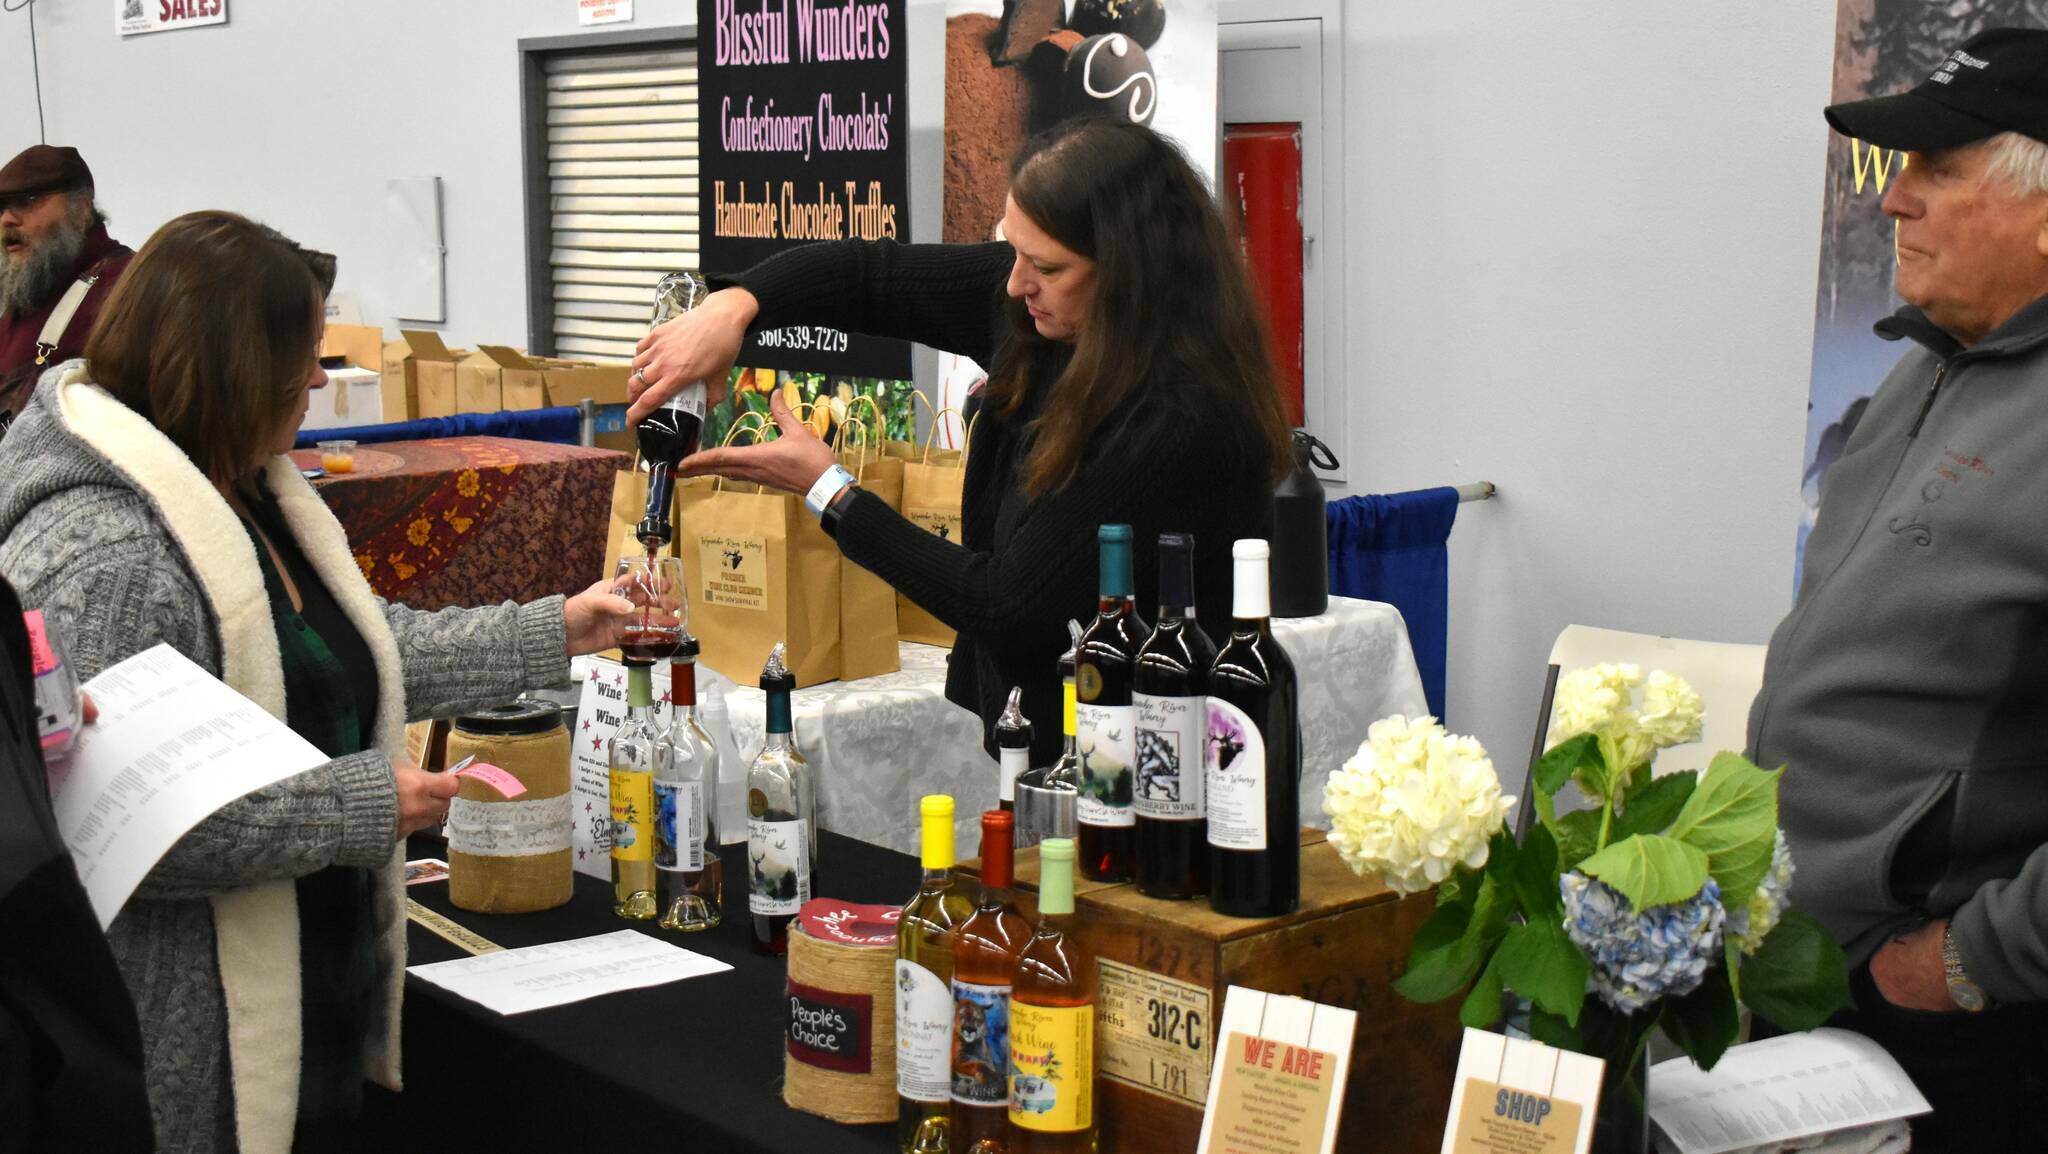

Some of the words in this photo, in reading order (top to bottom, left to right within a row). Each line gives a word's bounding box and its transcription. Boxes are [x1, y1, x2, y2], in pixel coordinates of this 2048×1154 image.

[715, 0, 790, 66] Blissful
[796, 0, 890, 64] Wunders
[721, 95, 813, 162] Confectionery
[714, 181, 778, 239] Handmade
[781, 181, 843, 241] Chocolate
[845, 181, 896, 242] Truffles
[597, 682, 622, 701] Wine
[596, 709, 621, 728] Wine
[1159, 701, 1188, 714] River
[1230, 773, 1257, 788] Winery
[1172, 803, 1198, 811] WINE
[790, 997, 847, 1033] People's
[792, 1021, 841, 1051] Choice
[1243, 1035, 1277, 1070] WE
[1280, 1045, 1324, 1080] ARE
[969, 1087, 999, 1098] WINE
[1494, 1088, 1553, 1126] SHOP
